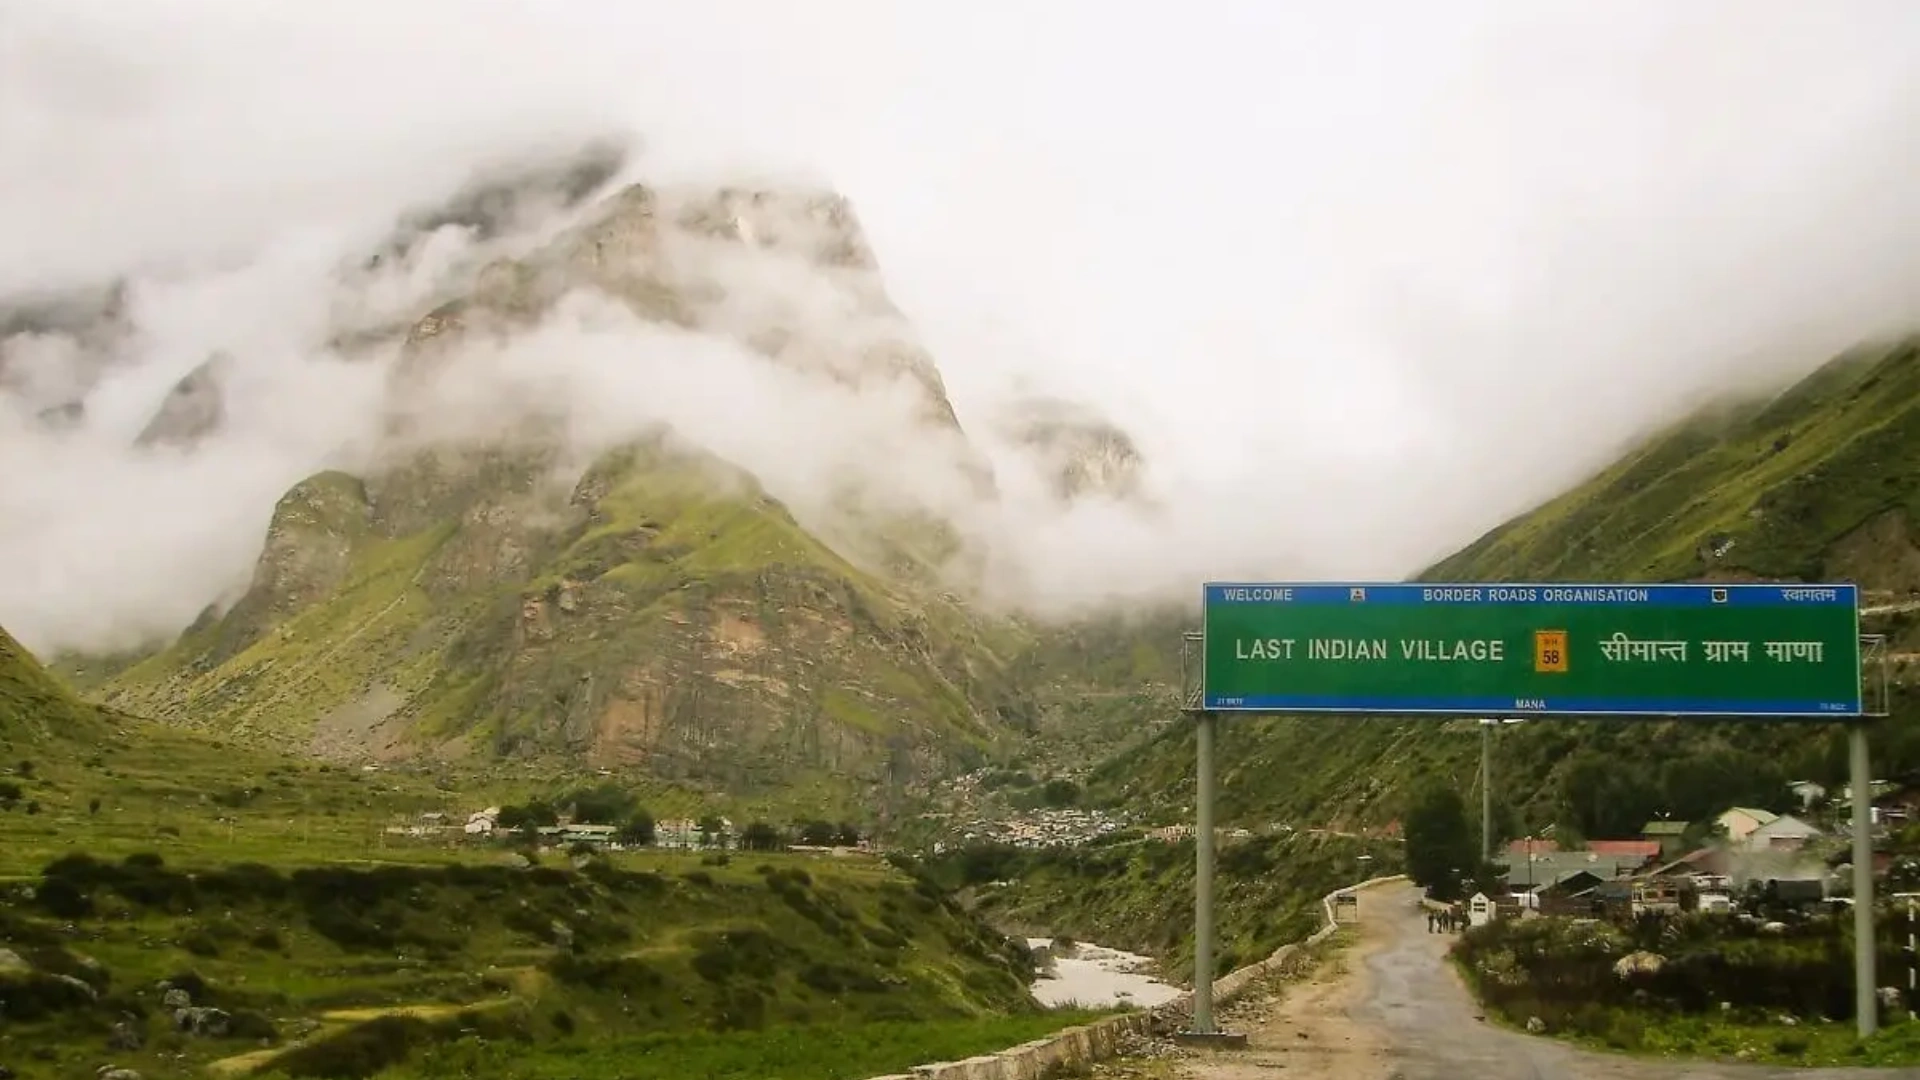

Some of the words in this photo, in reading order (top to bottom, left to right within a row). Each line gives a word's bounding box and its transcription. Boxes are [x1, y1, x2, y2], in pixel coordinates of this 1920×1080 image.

[1224, 588, 1293, 602] WELCOME
[1424, 588, 1481, 602] BORDER
[1489, 588, 1536, 602] ROADS
[1544, 588, 1648, 602] ORGANISATION
[1236, 639, 1296, 660] LAST
[1308, 639, 1387, 660] INDIAN
[1401, 639, 1504, 661] VILLAGE
[1599, 632, 1688, 662] सीमान्त
[1702, 641, 1750, 663] ग्राम
[1764, 641, 1824, 663] माणा
[1543, 650, 1559, 664] 58
[1515, 699, 1546, 709] MANA
